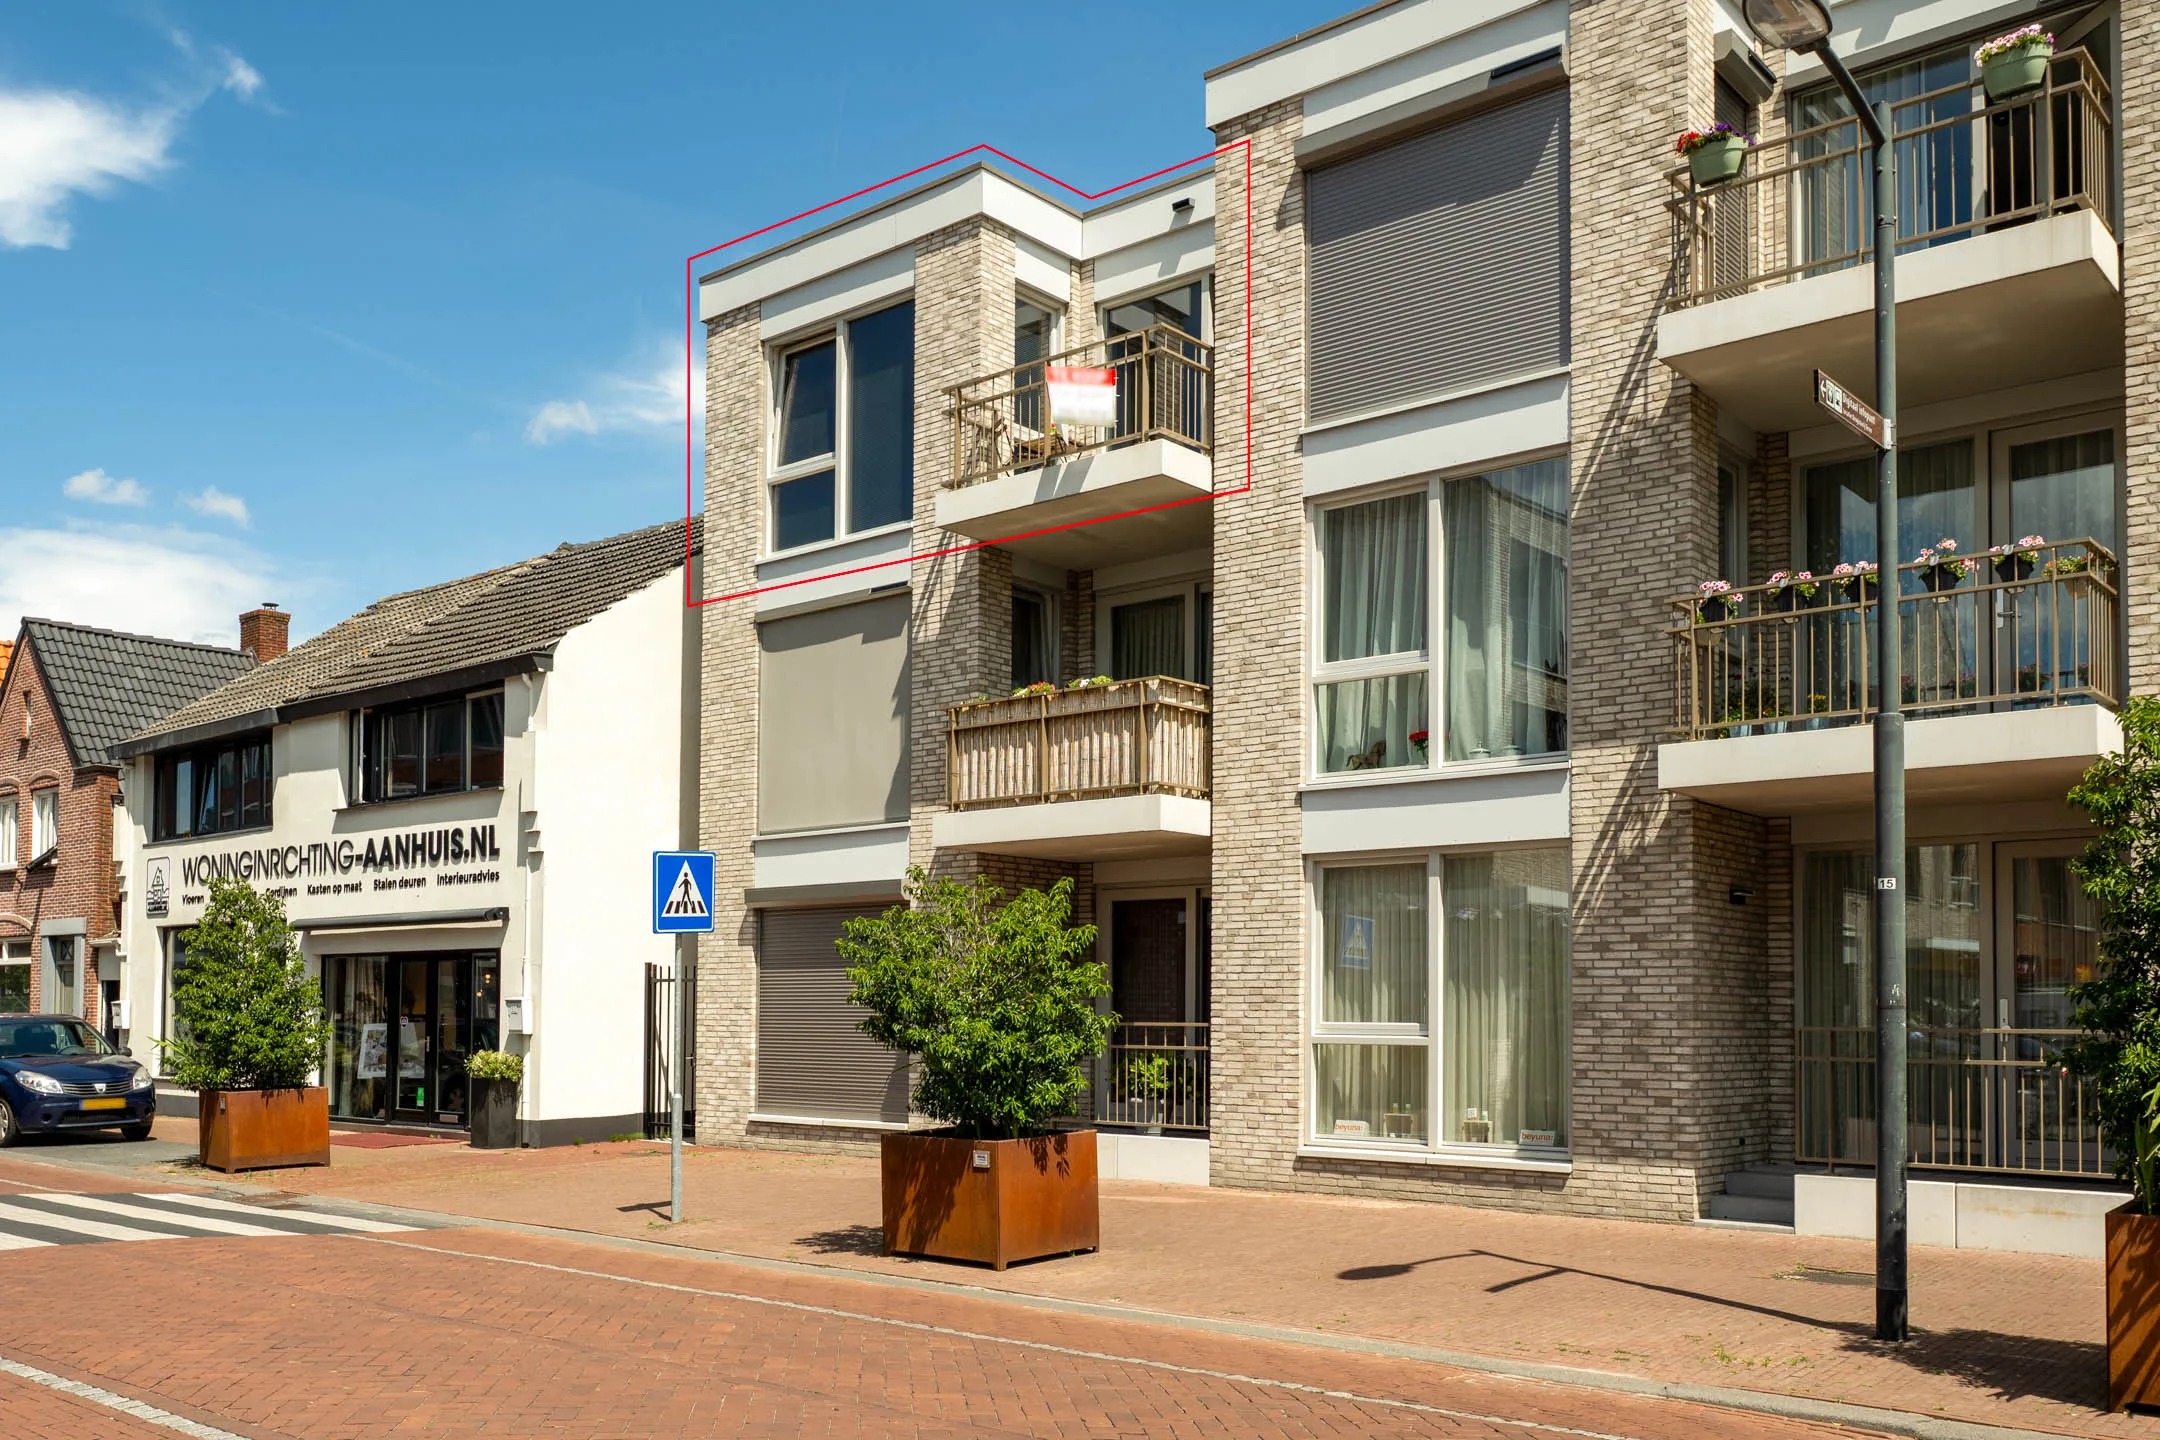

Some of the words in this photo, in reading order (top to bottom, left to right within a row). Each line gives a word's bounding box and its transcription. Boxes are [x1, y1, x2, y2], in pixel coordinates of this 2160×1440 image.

[182, 894, 205, 906] Vloeren
[307, 884, 331, 896] Kasten
[332, 883, 341, 896] op
[343, 881, 362, 893] maat
[373, 878, 397, 891] Stalen
[398, 876, 426, 889] deuren
[437, 869, 500, 886] Interieuradvies
[1879, 879, 1894, 889] 15
